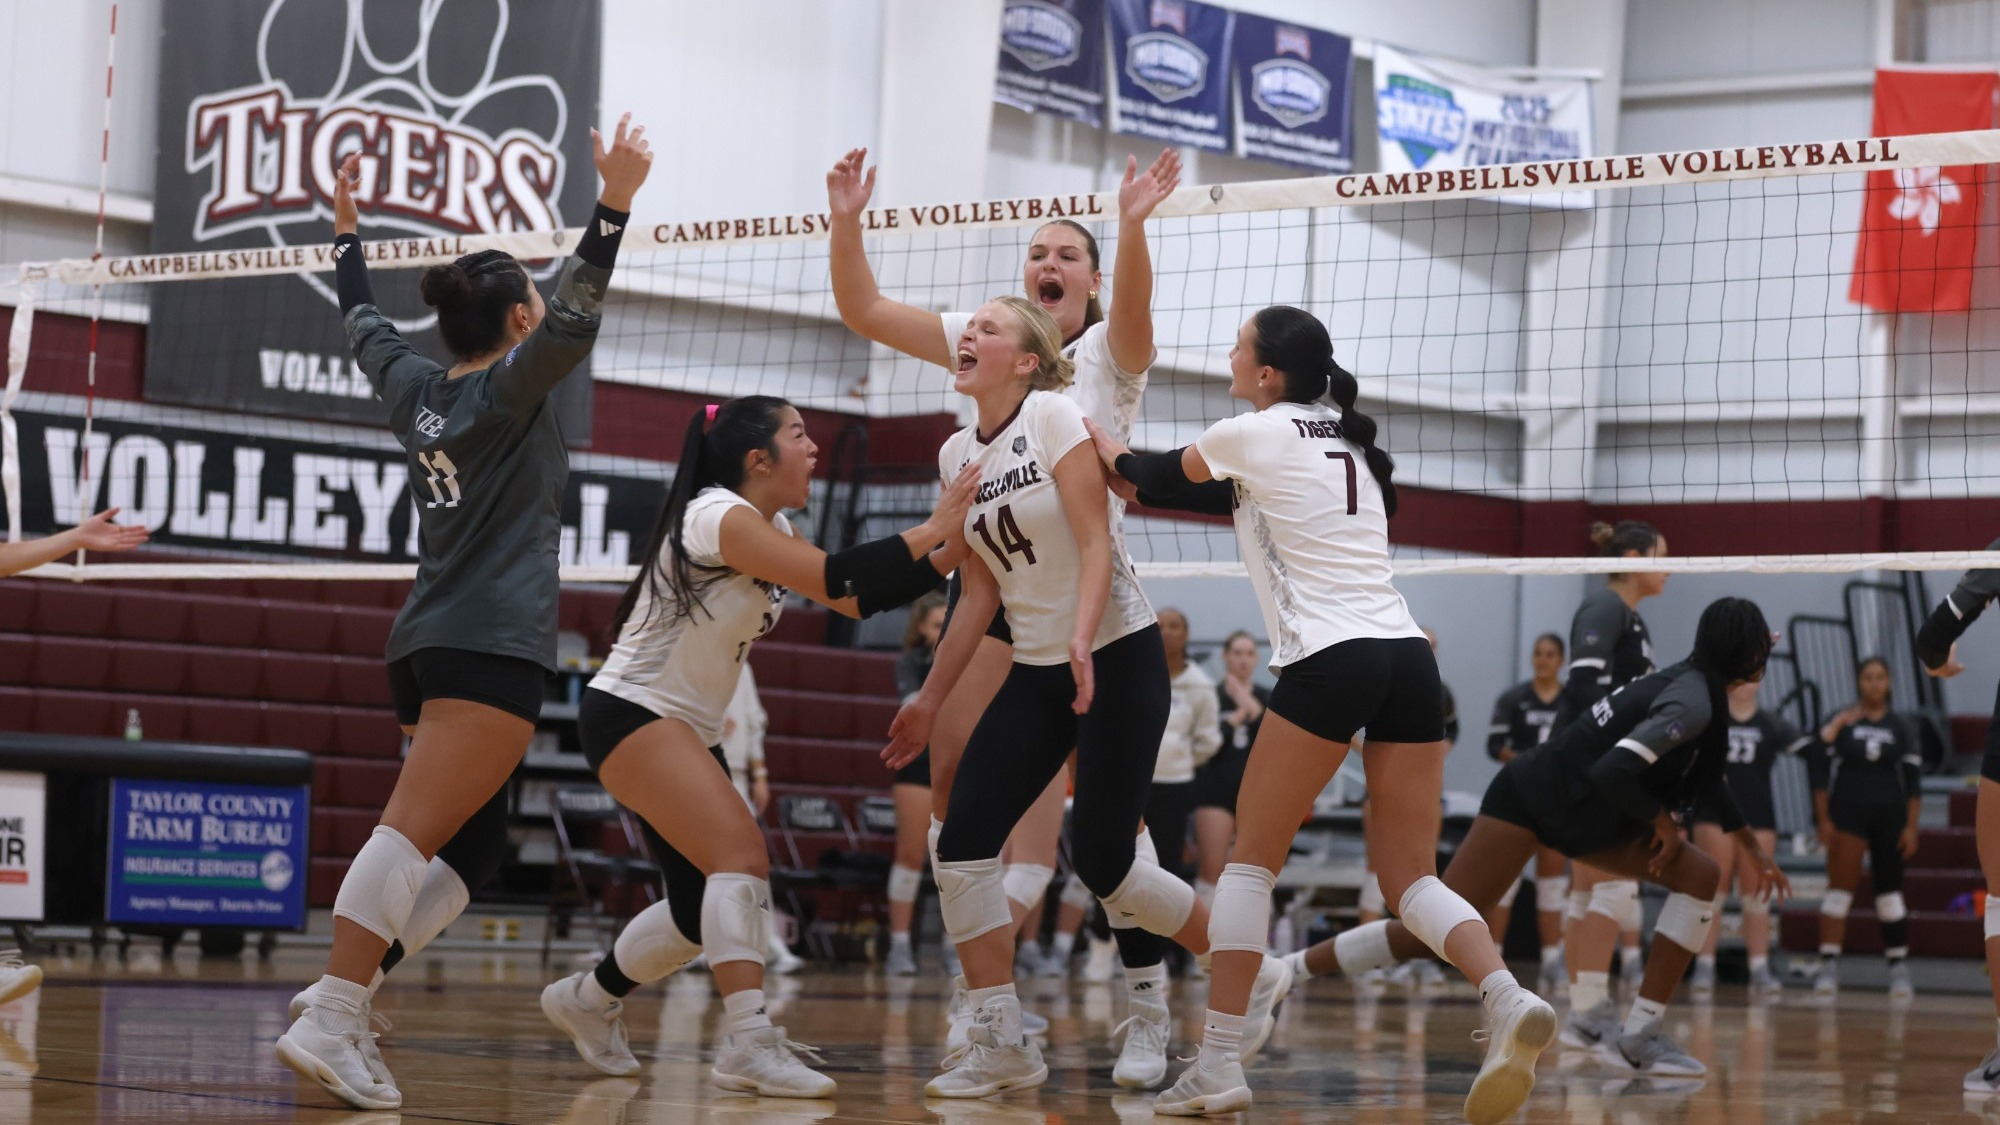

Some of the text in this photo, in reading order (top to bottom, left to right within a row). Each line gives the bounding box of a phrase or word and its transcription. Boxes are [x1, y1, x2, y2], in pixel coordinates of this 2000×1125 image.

[1379, 99, 1463, 143] STATES
[192, 86, 560, 262] TIGERS
[1335, 156, 1645, 199] CAMPBELLSVILLE
[1658, 138, 1900, 176] VOLLEYBALL
[653, 193, 1104, 245] CAMPBELLSVLE VOLLEYBALL
[108, 236, 469, 278] CAMPBELLSVILLE VLEYBALL
[258, 349, 374, 400] VOLLE
[415, 405, 447, 438] TIGE
[1291, 418, 1344, 439] TIGER
[44, 427, 631, 566] VOLLEYL
[418, 450, 462, 509] 11
[974, 460, 1042, 505] BELLSVILLE
[1324, 451, 1357, 516] 7
[972, 504, 1037, 573] 14
[128, 789, 295, 819] TAYLOR COUNTY
[126, 812, 293, 847] FARM BUREAU
[123, 857, 197, 878] INSURANCE
[198, 859, 258, 880] SERVICES
